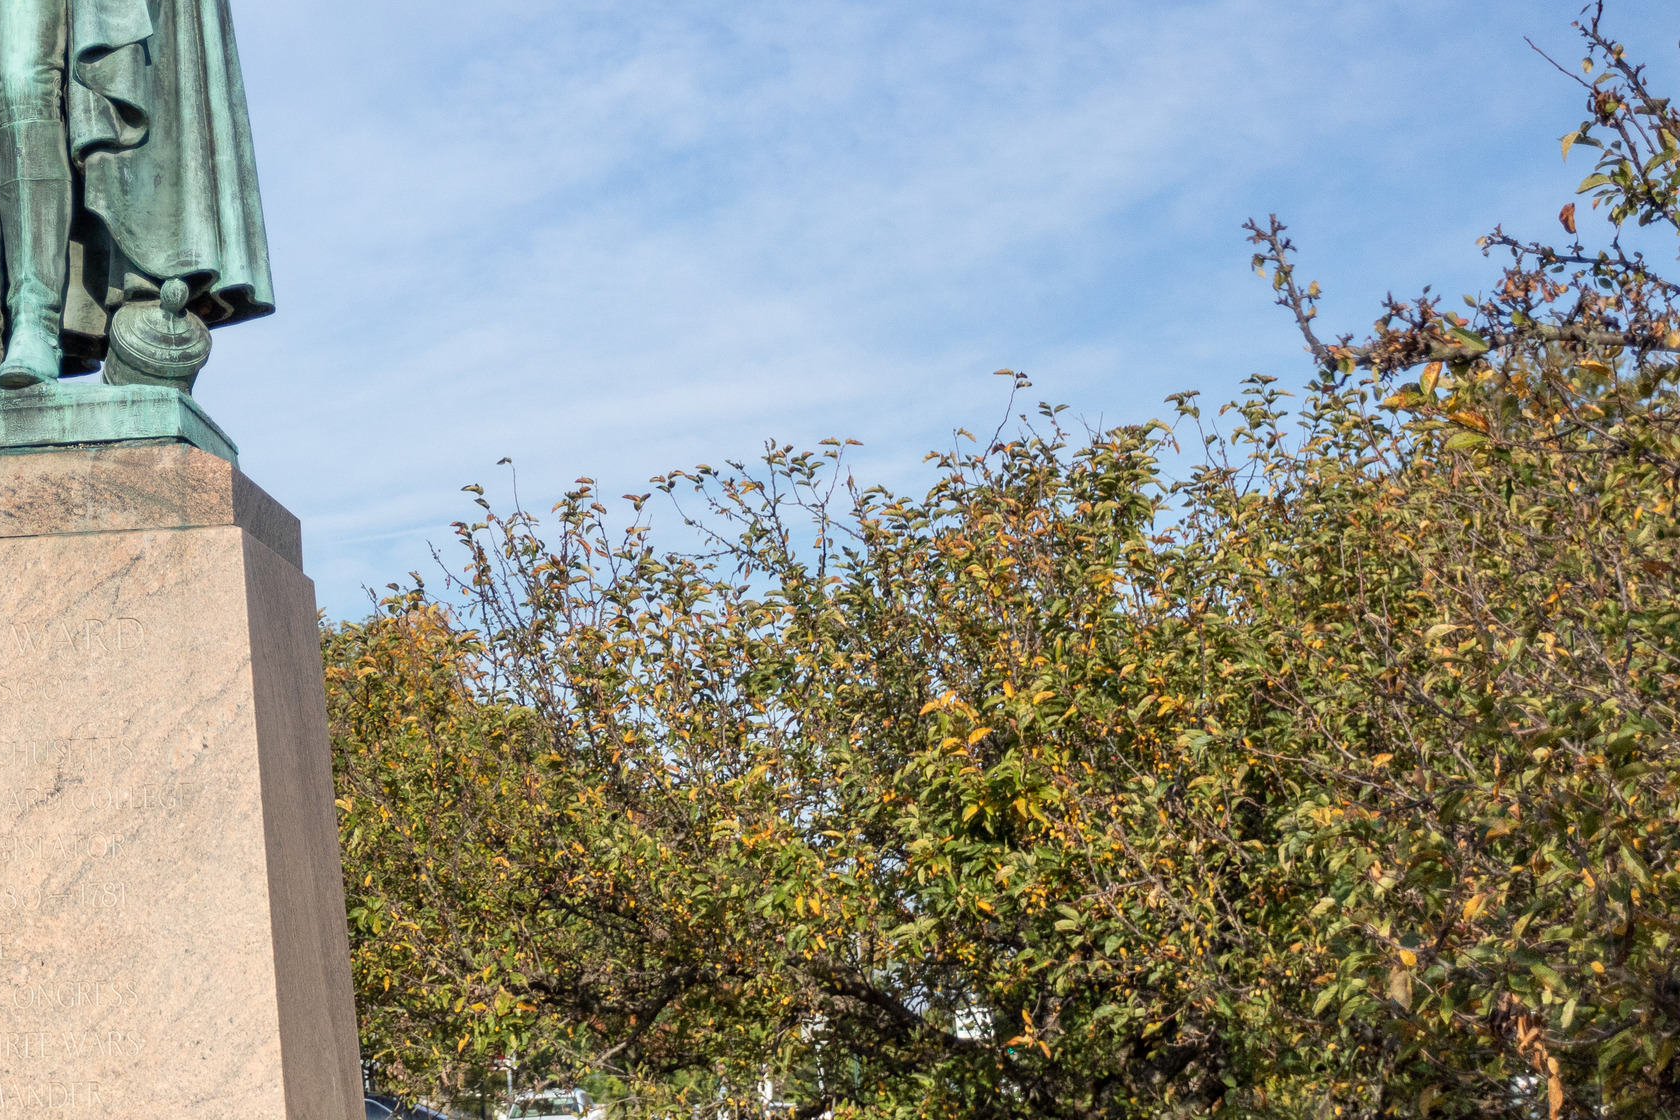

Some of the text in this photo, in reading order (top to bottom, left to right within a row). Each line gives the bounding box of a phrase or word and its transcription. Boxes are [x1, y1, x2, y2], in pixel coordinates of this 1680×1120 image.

[8, 617, 145, 656] WARD
[71, 782, 195, 813] COLLEGE
[80, 882, 126, 908] 1781
[61, 1030, 139, 1057] WARS
